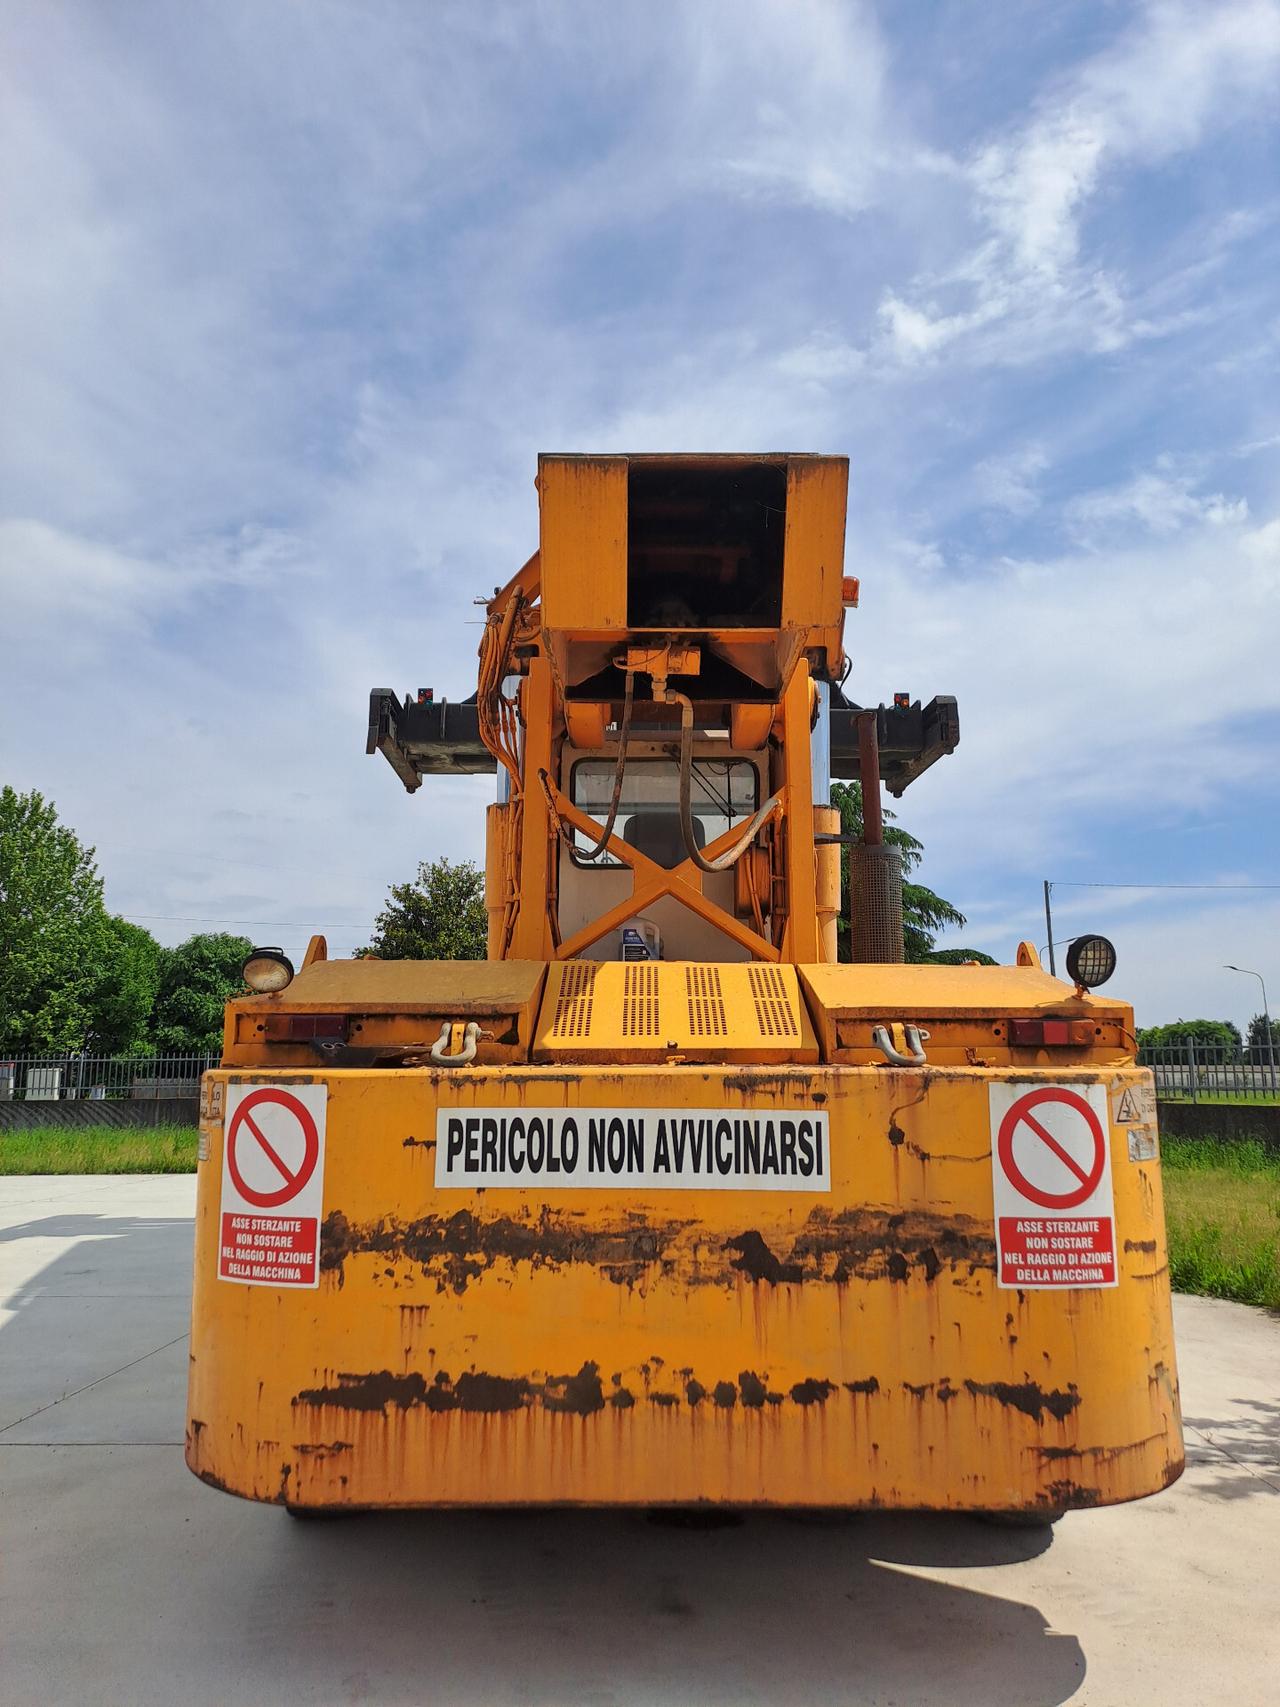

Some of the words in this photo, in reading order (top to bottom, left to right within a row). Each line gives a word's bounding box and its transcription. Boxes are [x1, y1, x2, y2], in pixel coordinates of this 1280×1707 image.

[447, 1117, 578, 1173] PERICOLO
[588, 1117, 644, 1173] NON
[653, 1118, 823, 1177] AVVICINARSI
[232, 1217, 250, 1229] ASSE
[251, 1219, 301, 1232] STERZANTE
[1016, 1221, 1043, 1233] ASSE
[1046, 1221, 1099, 1232] STERZANTE
[236, 1233, 252, 1245] NON
[253, 1234, 293, 1248] SOSTARE
[1025, 1237, 1048, 1249] NON
[1050, 1237, 1093, 1249] SOSTARE
[222, 1246, 235, 1259] NEL
[235, 1247, 265, 1262] RAGGIO
[266, 1251, 276, 1262] DI
[277, 1252, 313, 1264] AZIONE
[1004, 1252, 1024, 1265] NEL
[1027, 1253, 1066, 1265] RAGGIO
[1068, 1253, 1079, 1265] DI
[1080, 1251, 1112, 1264] AZIONE
[228, 1262, 251, 1276] DELLA
[252, 1265, 301, 1280] MACCHINA
[1016, 1269, 1051, 1281] DELLA
[1052, 1268, 1104, 1281] MACCHINA
